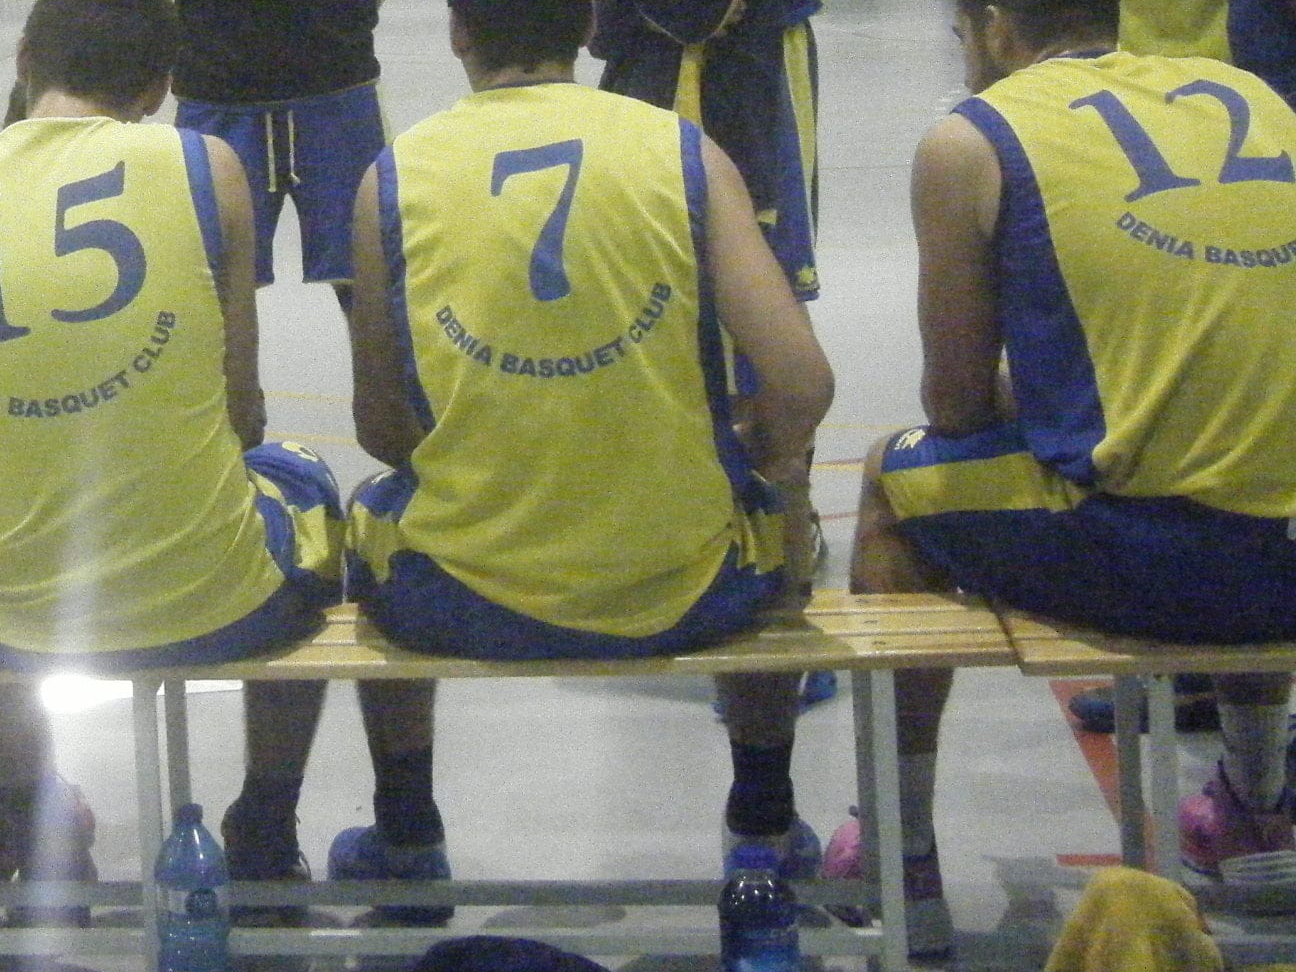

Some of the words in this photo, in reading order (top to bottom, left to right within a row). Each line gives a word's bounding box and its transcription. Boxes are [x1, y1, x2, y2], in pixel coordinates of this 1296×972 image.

[1068, 78, 1296, 203] 12
[490, 138, 584, 302] 7
[1116, 211, 1195, 260] DENIA
[7, 369, 131, 419] BASQUET
[132, 310, 177, 374] CLUB
[435, 304, 493, 367] DENIA
[500, 336, 626, 379] BASQUET
[628, 282, 673, 344] CLUB
